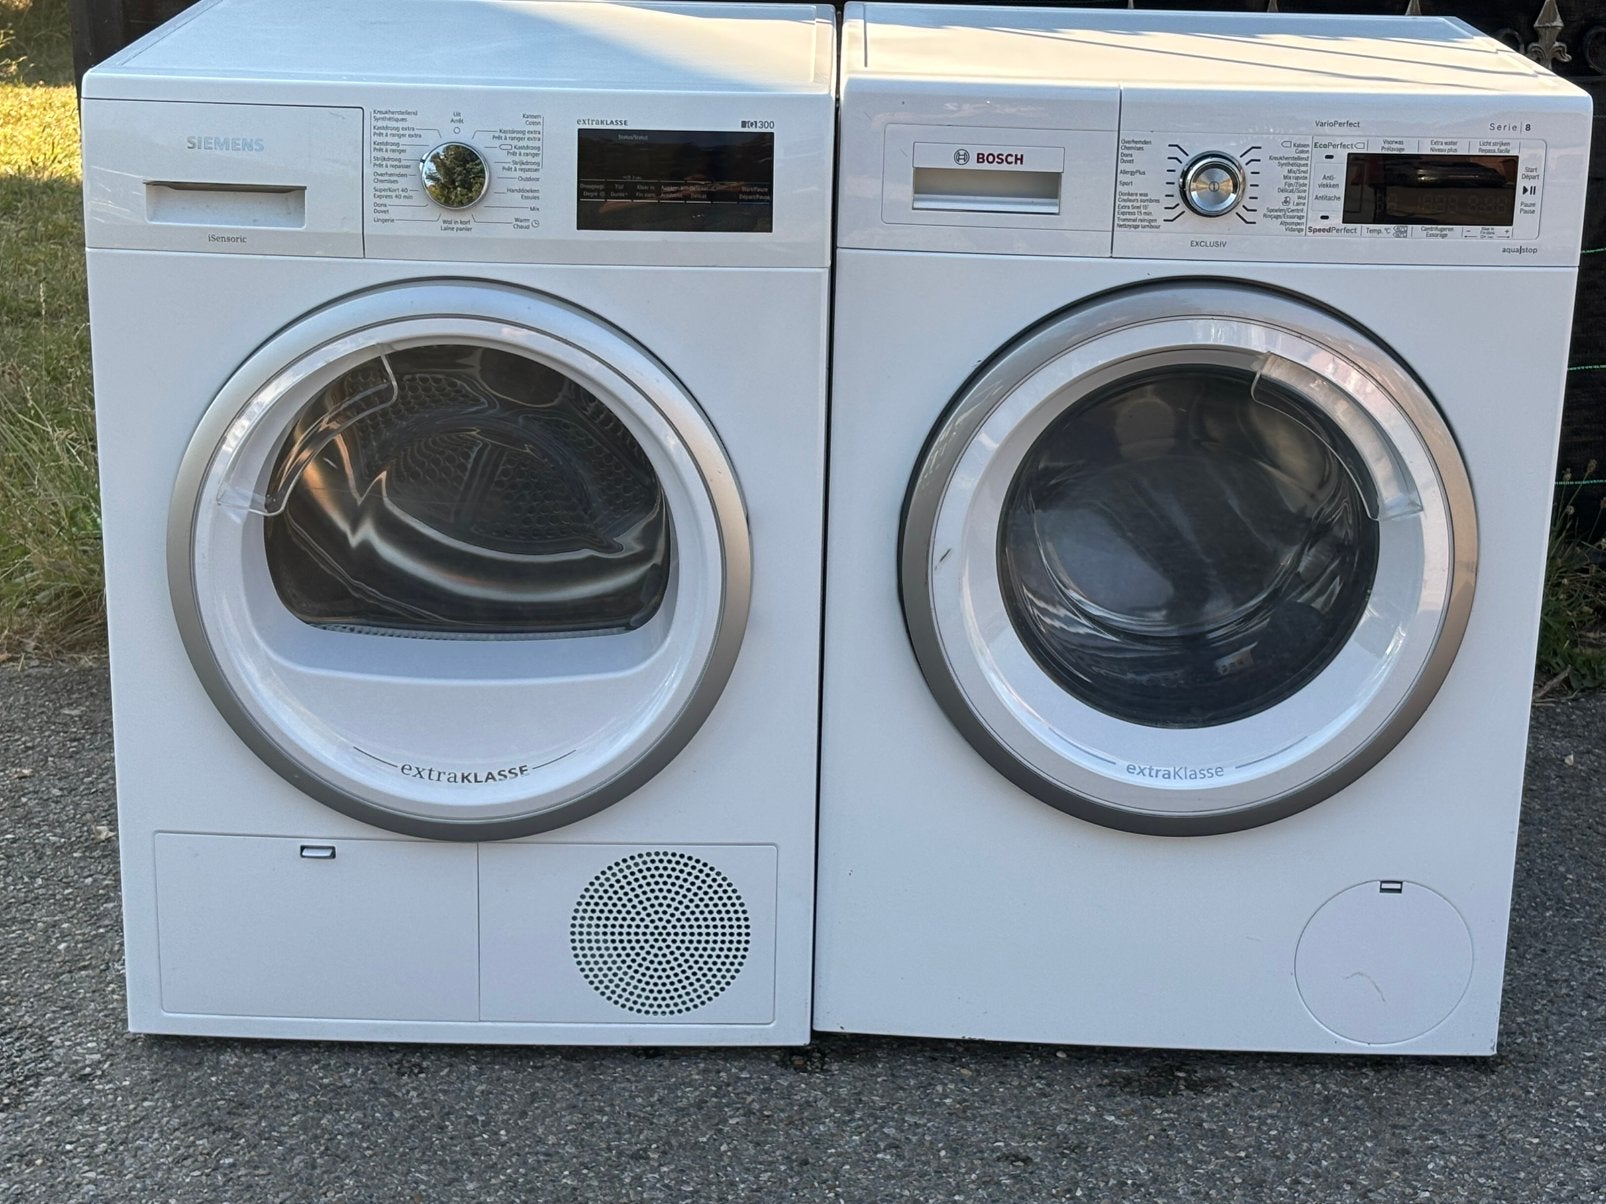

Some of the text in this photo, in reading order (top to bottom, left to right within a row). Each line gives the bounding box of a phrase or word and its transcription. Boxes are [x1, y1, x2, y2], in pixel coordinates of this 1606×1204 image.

[1490, 122, 1517, 131] Serie
[187, 136, 264, 151] SIEMENS
[976, 153, 1024, 165] BOSCH
[208, 234, 247, 243] iSensoric
[401, 763, 529, 784] extraKLASSE
[1126, 764, 1224, 780] extraKlasse
